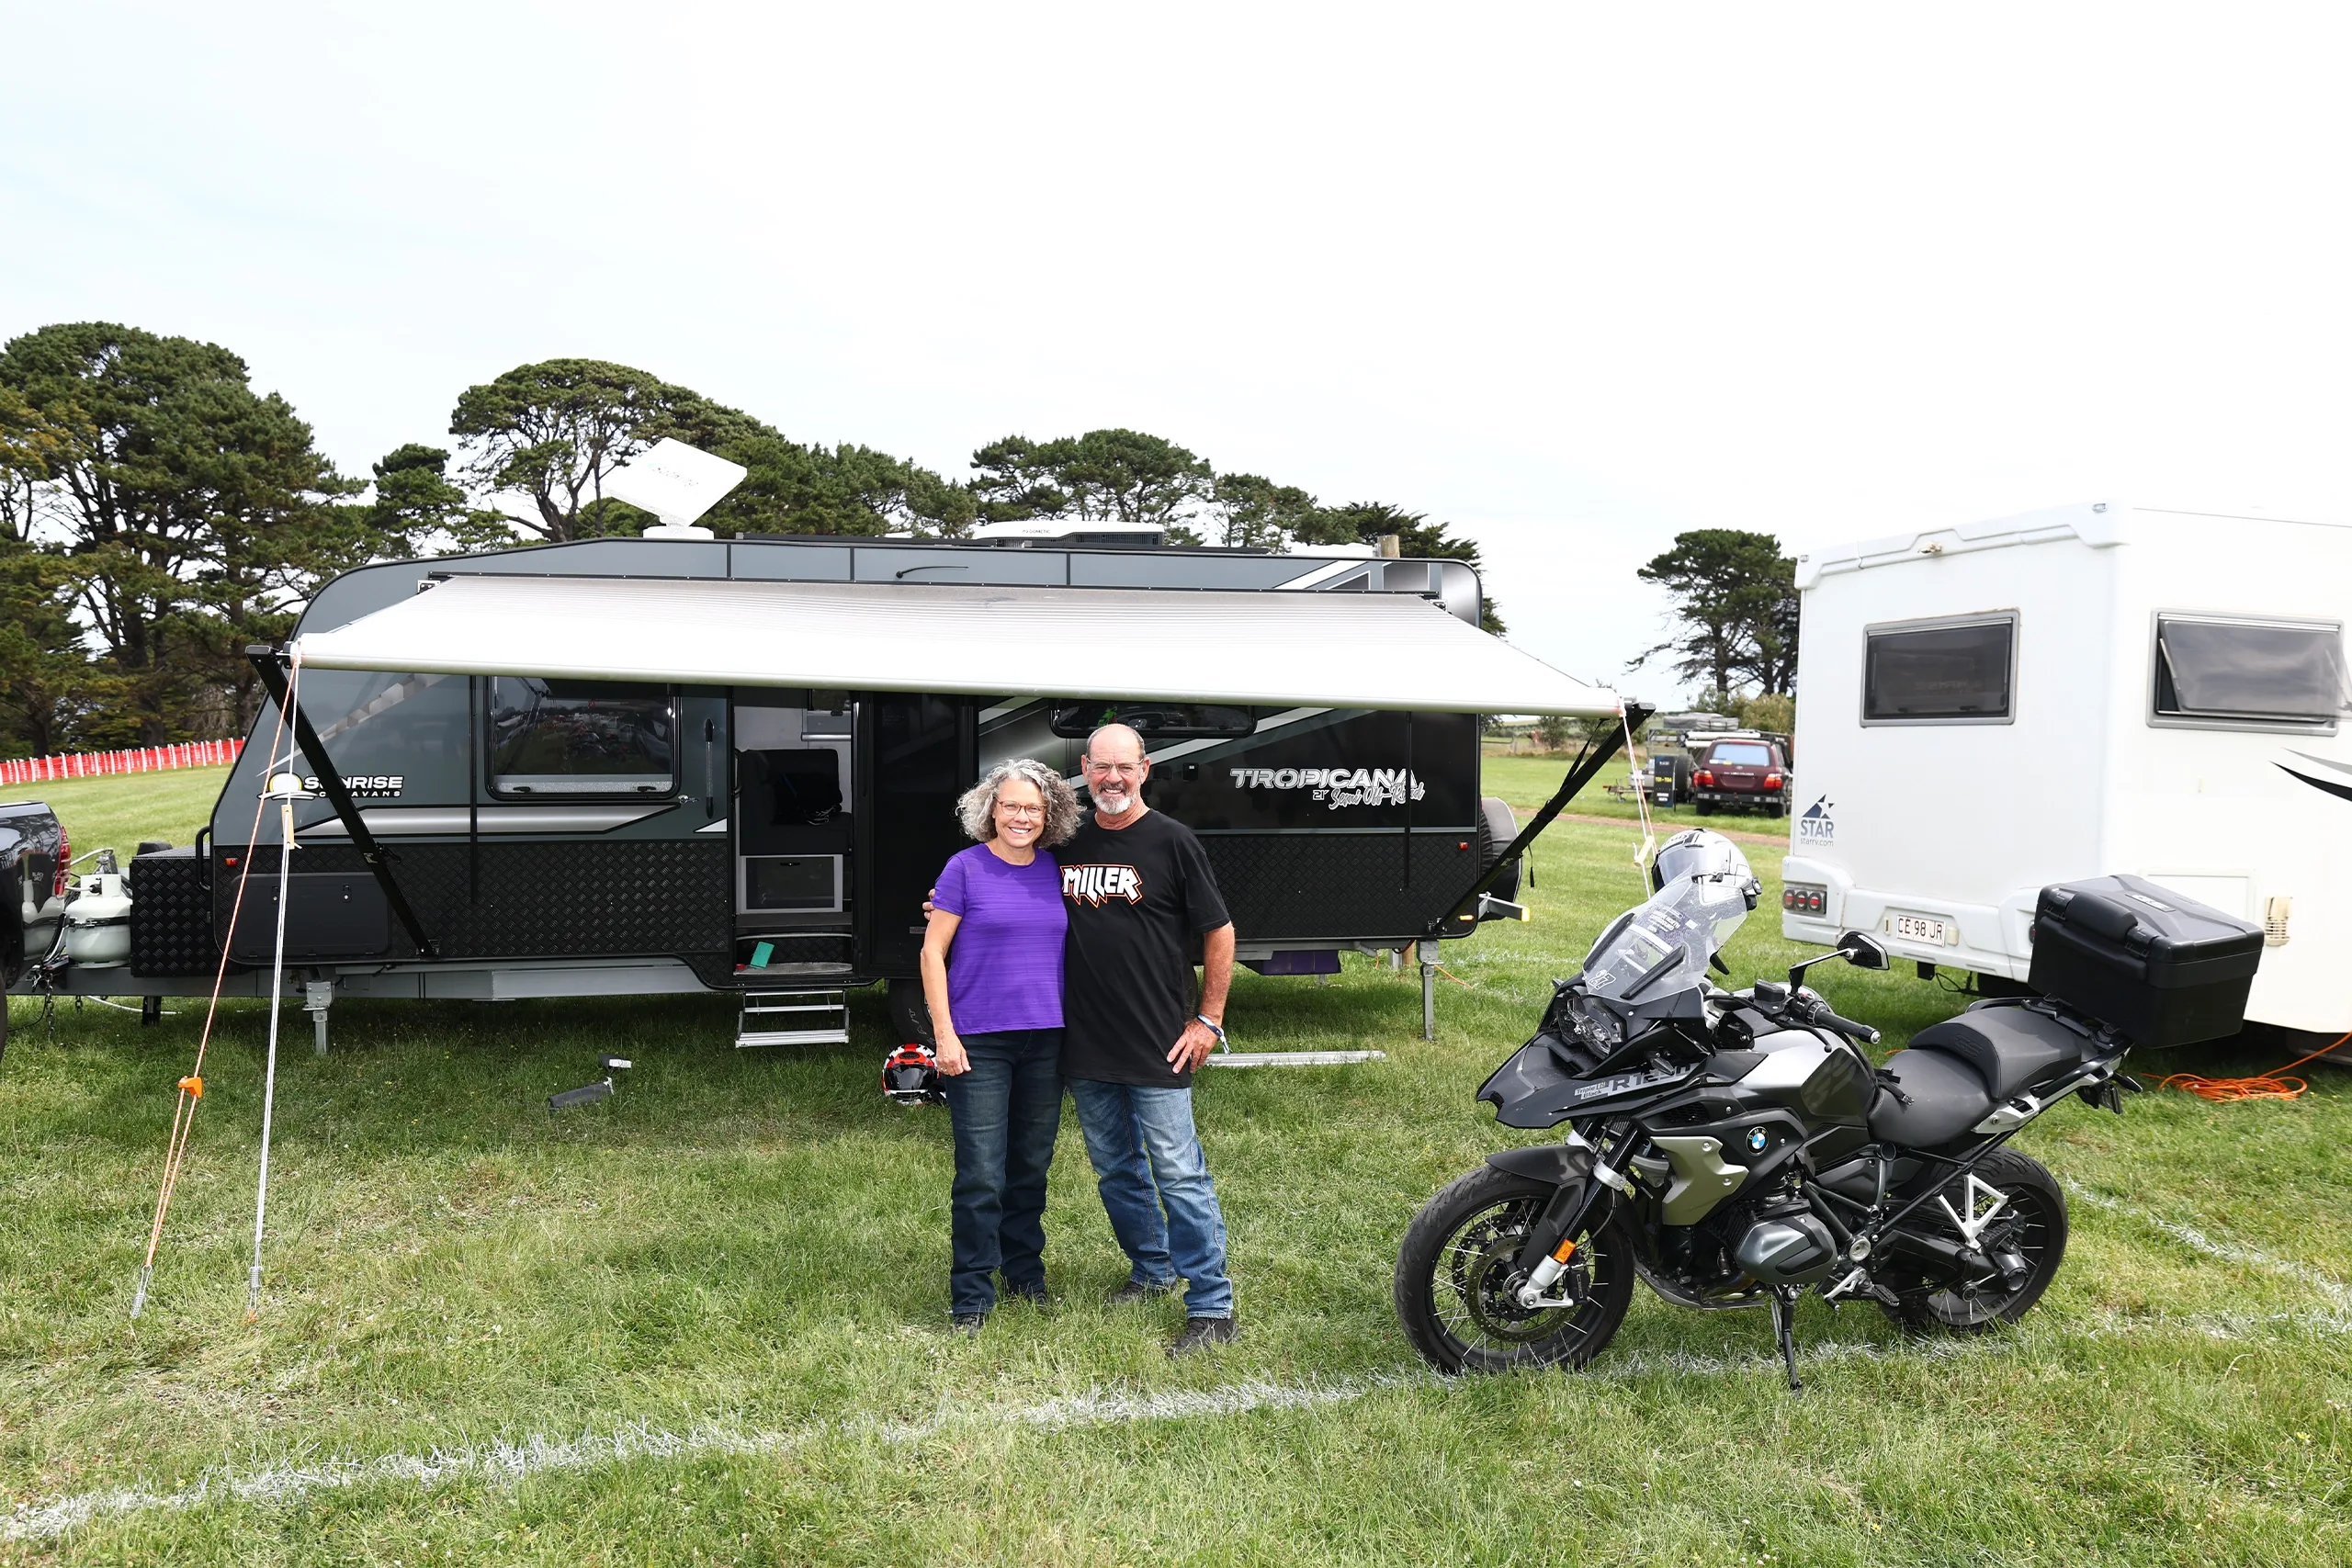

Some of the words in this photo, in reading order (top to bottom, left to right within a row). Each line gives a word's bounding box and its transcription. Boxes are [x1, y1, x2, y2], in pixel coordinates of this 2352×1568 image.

[304, 776, 403, 789] SNRISE
[1230, 768, 1418, 789] TROPICANA
[1329, 788, 1363, 810] Semi
[1801, 819, 1835, 838] STAR
[1800, 838, 1834, 847] starrv.com
[1061, 865, 1141, 906] MILLER
[1898, 918, 1910, 934] CE
[1914, 920, 1927, 937] 98
[1929, 921, 1943, 940] JR
